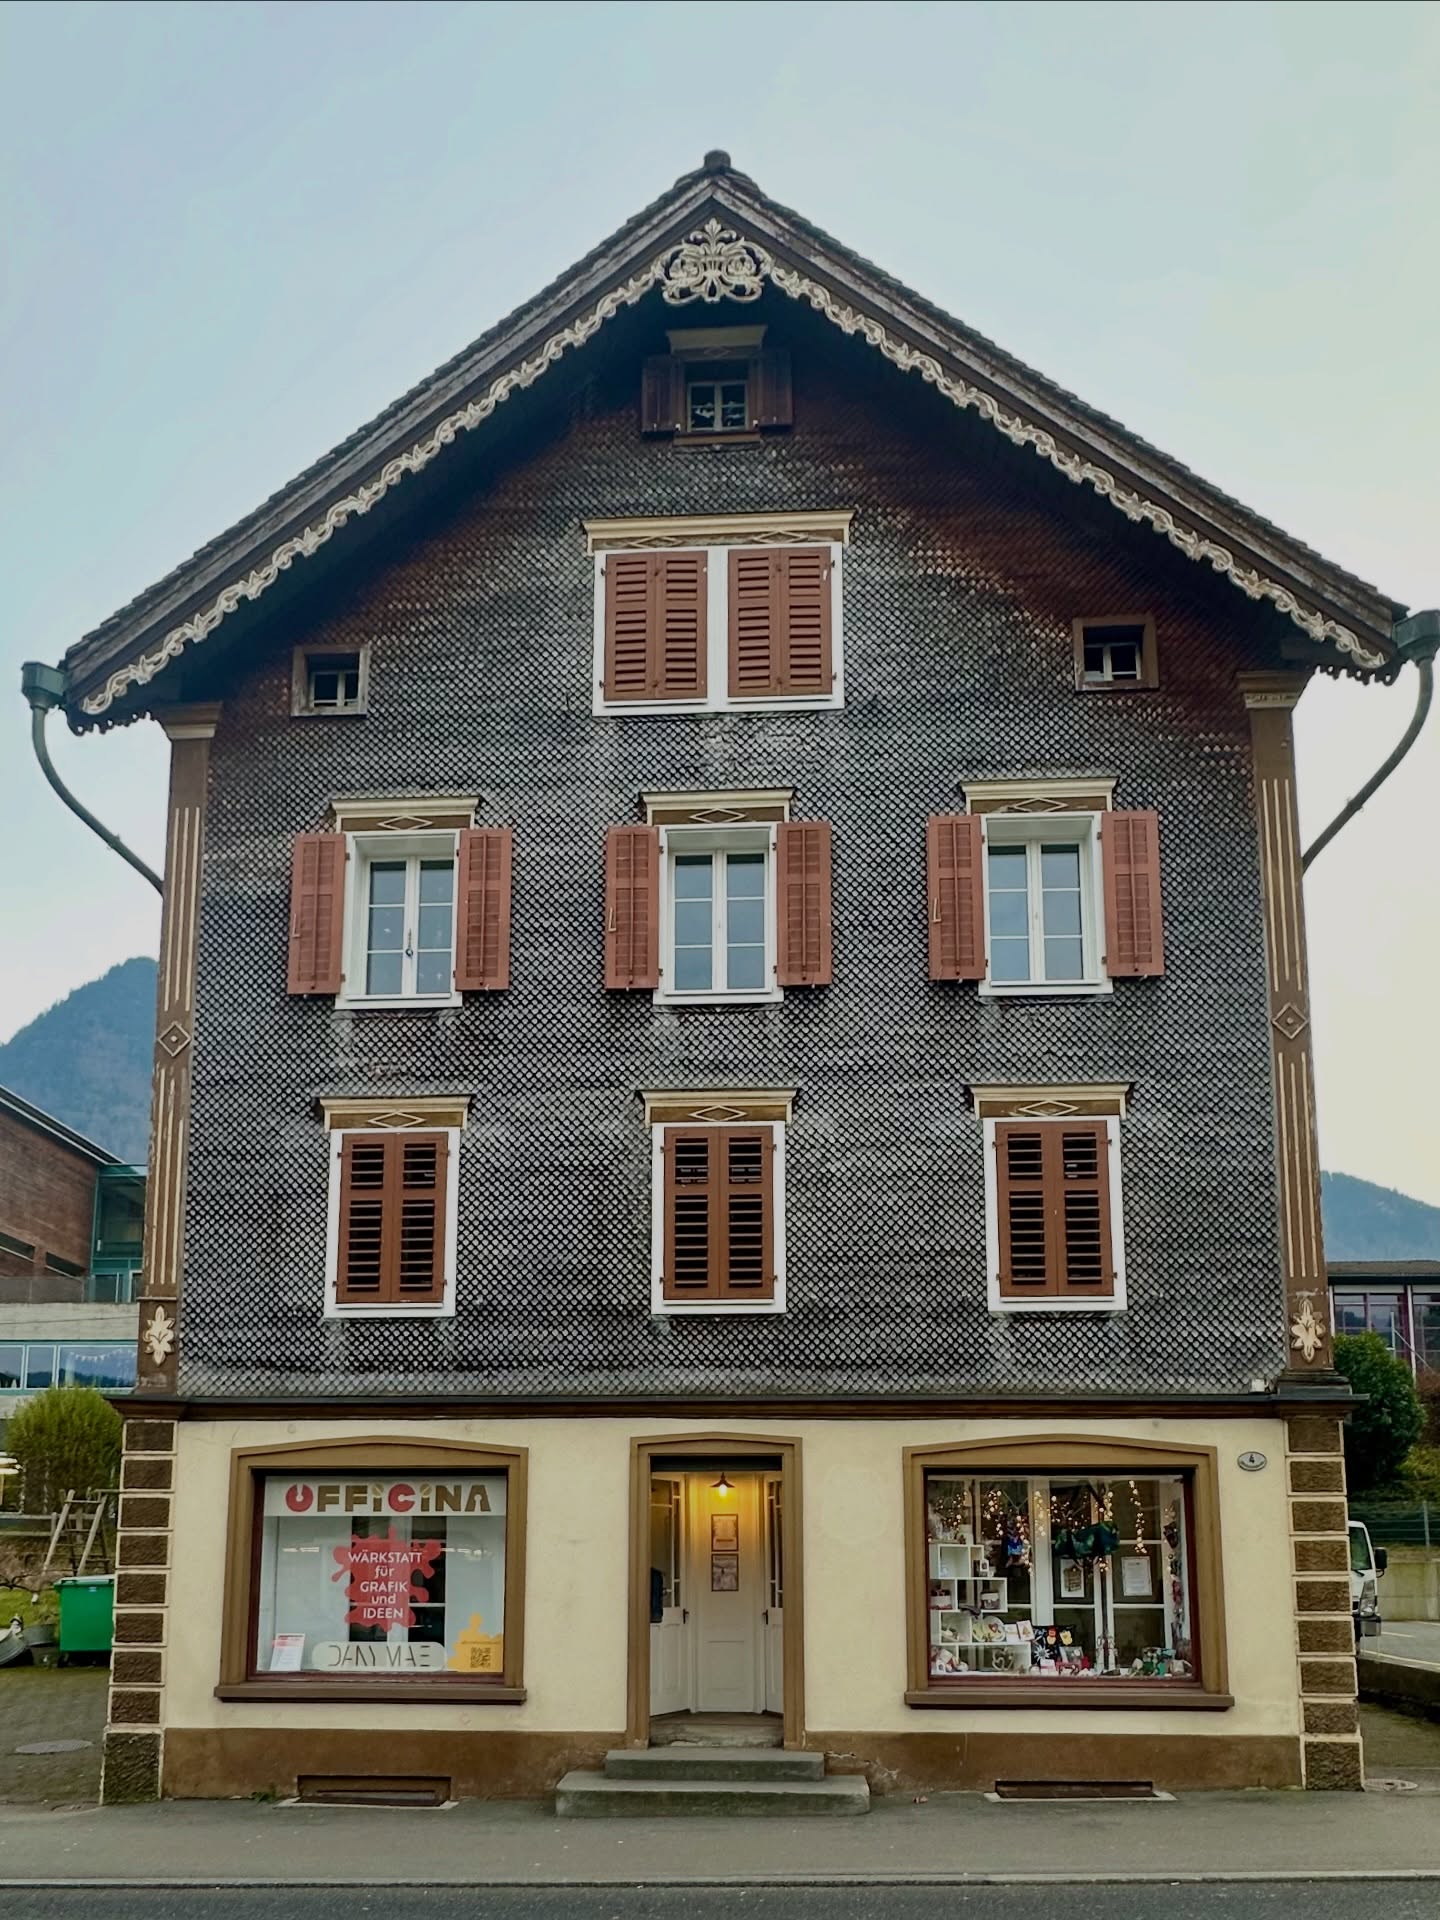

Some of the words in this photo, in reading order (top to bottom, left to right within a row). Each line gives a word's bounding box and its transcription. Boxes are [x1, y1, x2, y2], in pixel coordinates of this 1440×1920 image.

[1249, 1453, 1255, 1464] 4
[374, 1565, 395, 1579] für
[360, 1581, 408, 1593] GRAFIK
[371, 1593, 397, 1604] und
[363, 1607, 403, 1619] IDEEN
